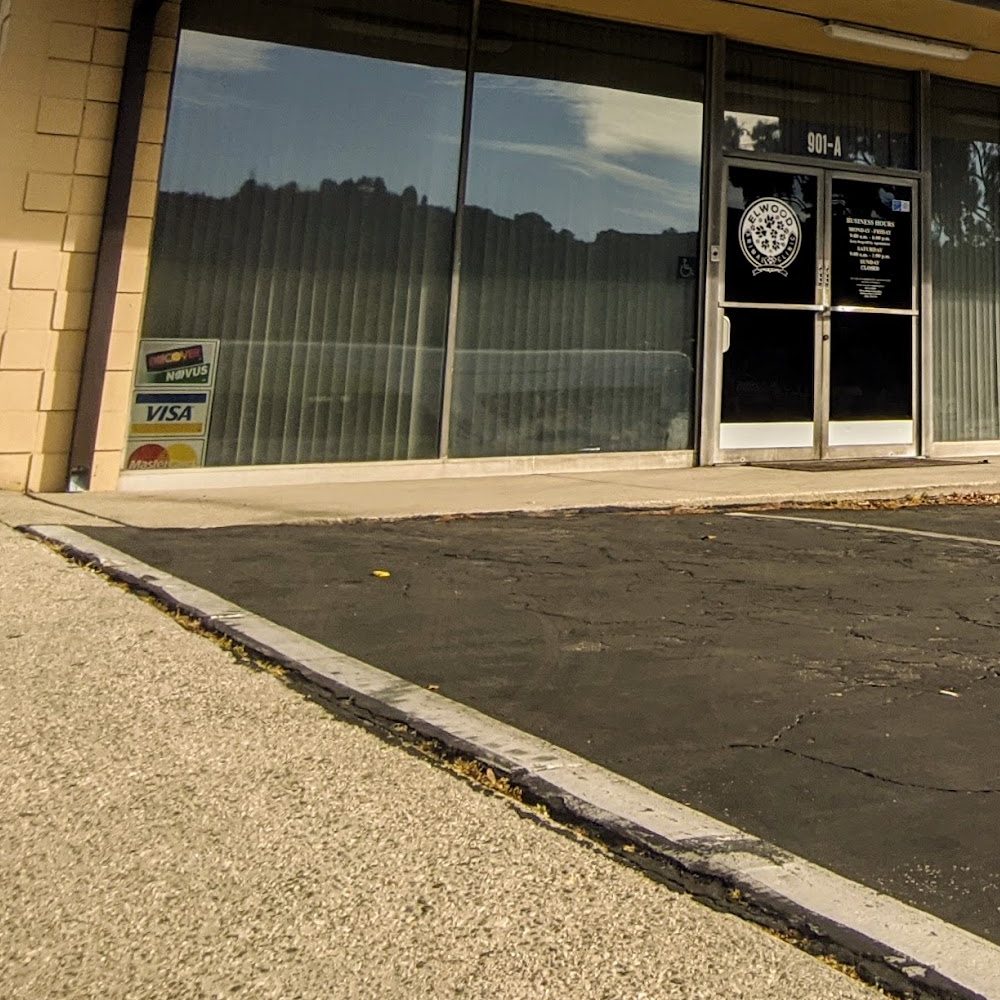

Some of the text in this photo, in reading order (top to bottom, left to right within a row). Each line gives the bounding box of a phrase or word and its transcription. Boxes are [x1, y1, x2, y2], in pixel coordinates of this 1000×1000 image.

[807, 131, 842, 157] 901-A
[747, 203, 793, 226] ELWOOD
[165, 365, 209, 382] NOVUS
[146, 405, 193, 421] VISA
